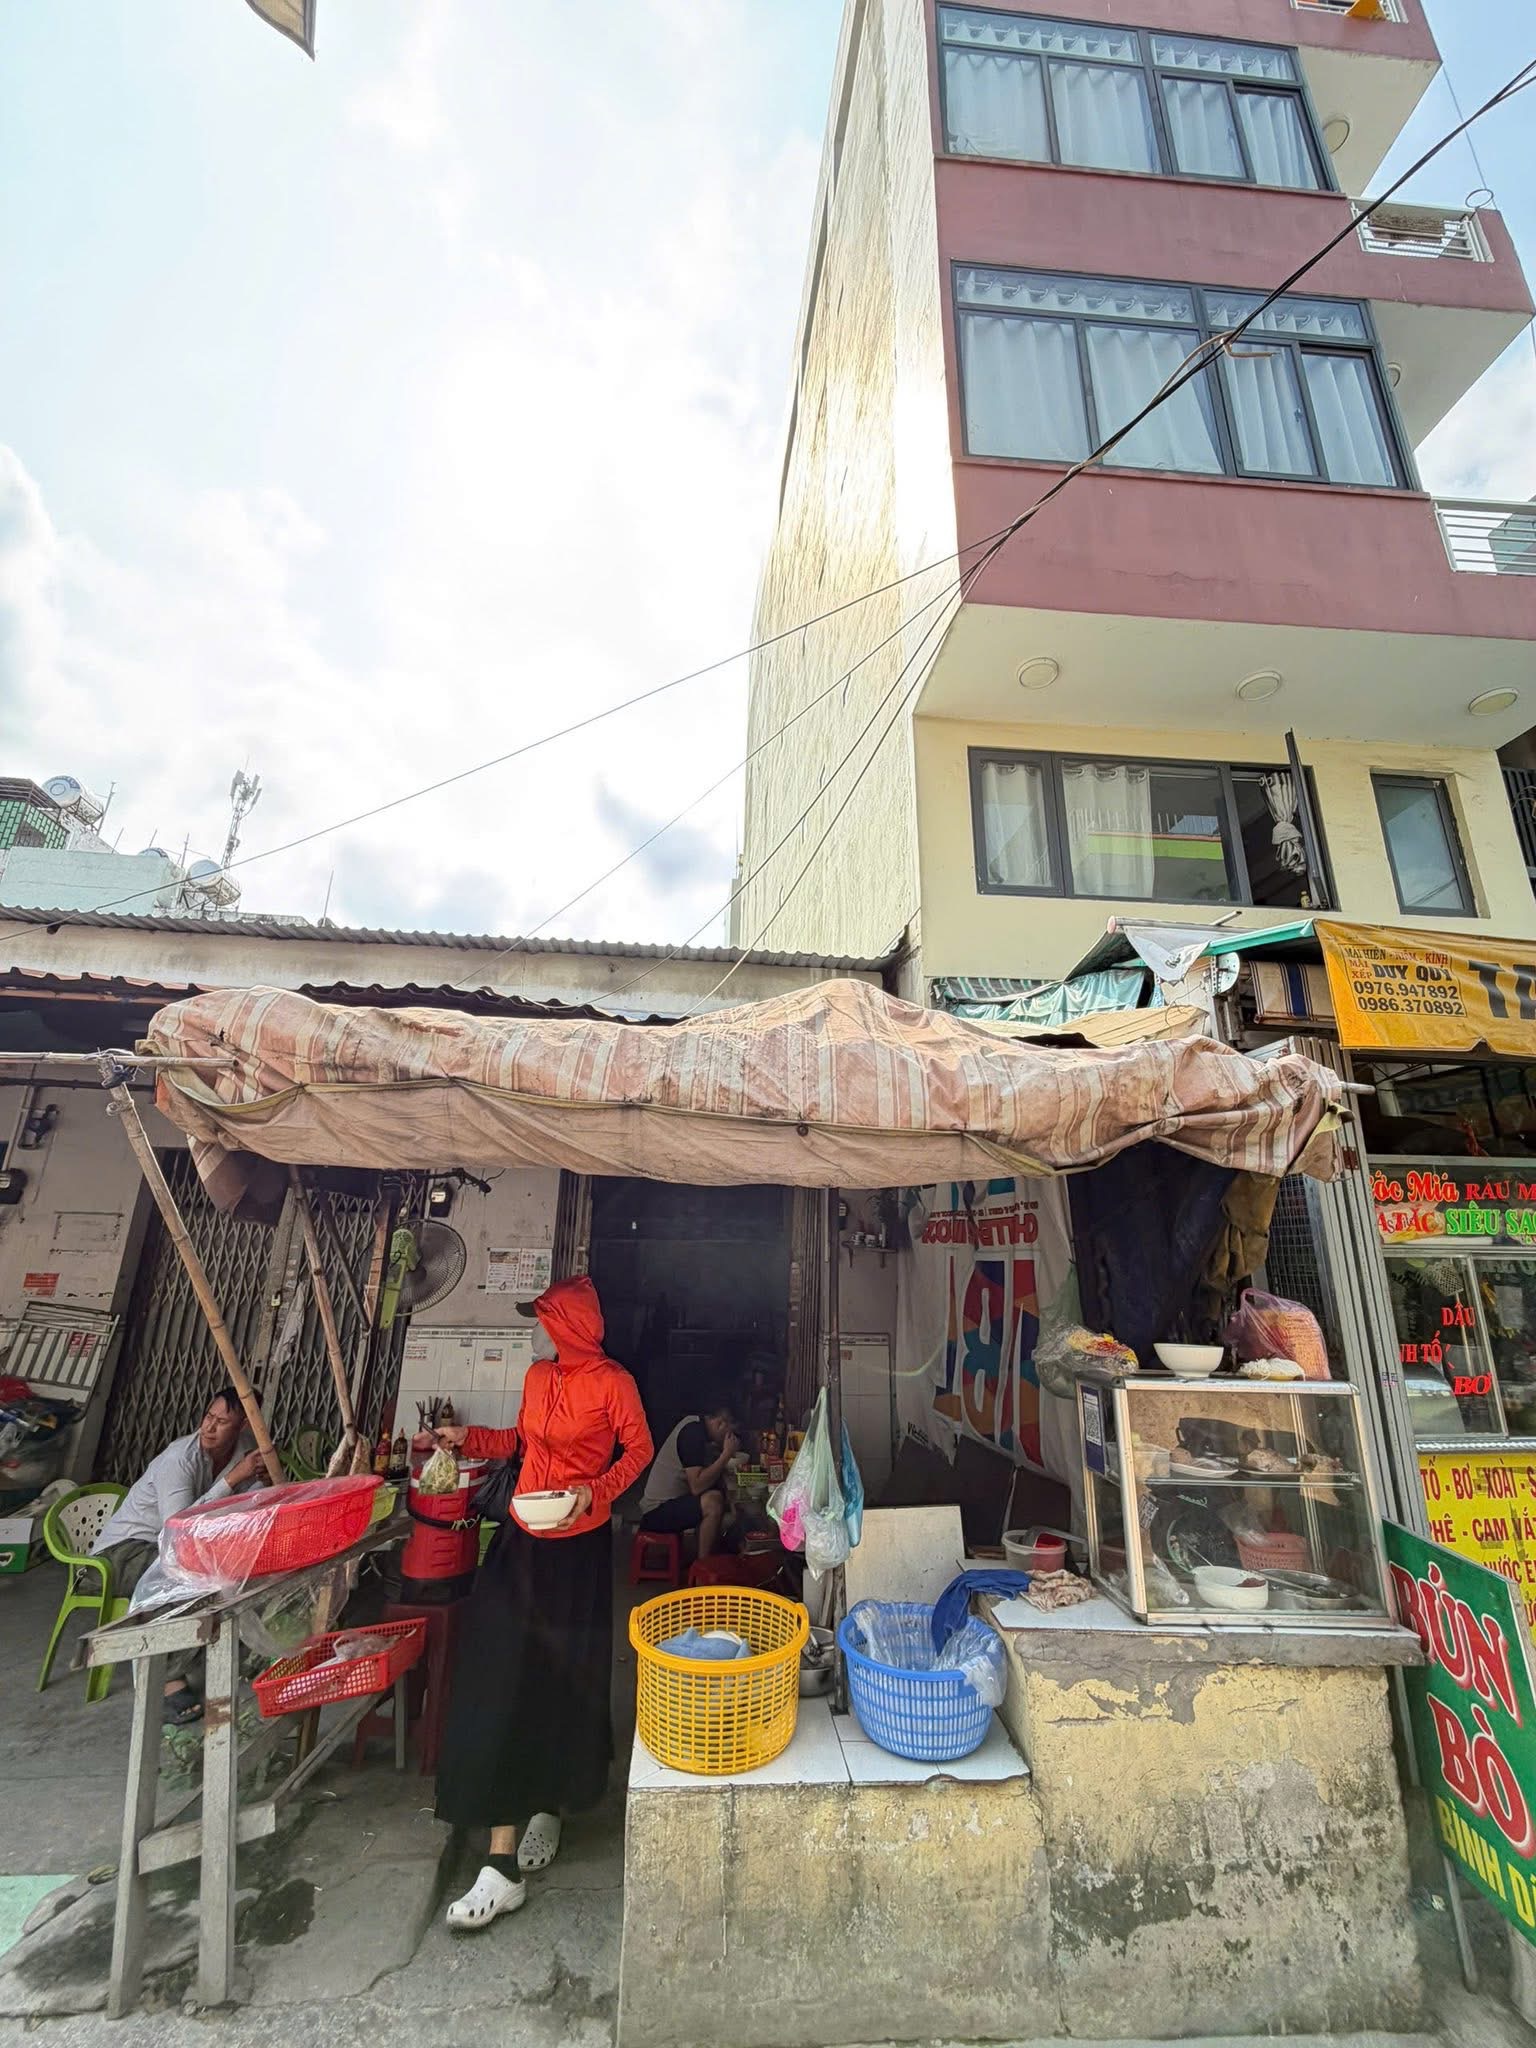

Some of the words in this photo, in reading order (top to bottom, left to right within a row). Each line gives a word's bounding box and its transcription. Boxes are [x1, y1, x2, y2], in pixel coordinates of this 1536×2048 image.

[1371, 963, 1408, 980] DUY
[1353, 980, 1459, 999] 0976.947892
[1357, 996, 1464, 1015] 0986.370892
[1369, 1169, 1404, 1202] ớc
[1406, 1169, 1460, 1203] Mía
[1444, 1200, 1500, 1236] SIÊU
[1504, 1208, 1536, 1245] SẠ
[1483, 1457, 1518, 1500] XOÀI
[1472, 1517, 1510, 1543] CAM
[1511, 1507, 1536, 1542] VẮ
[1506, 1861, 1536, 1928] D
